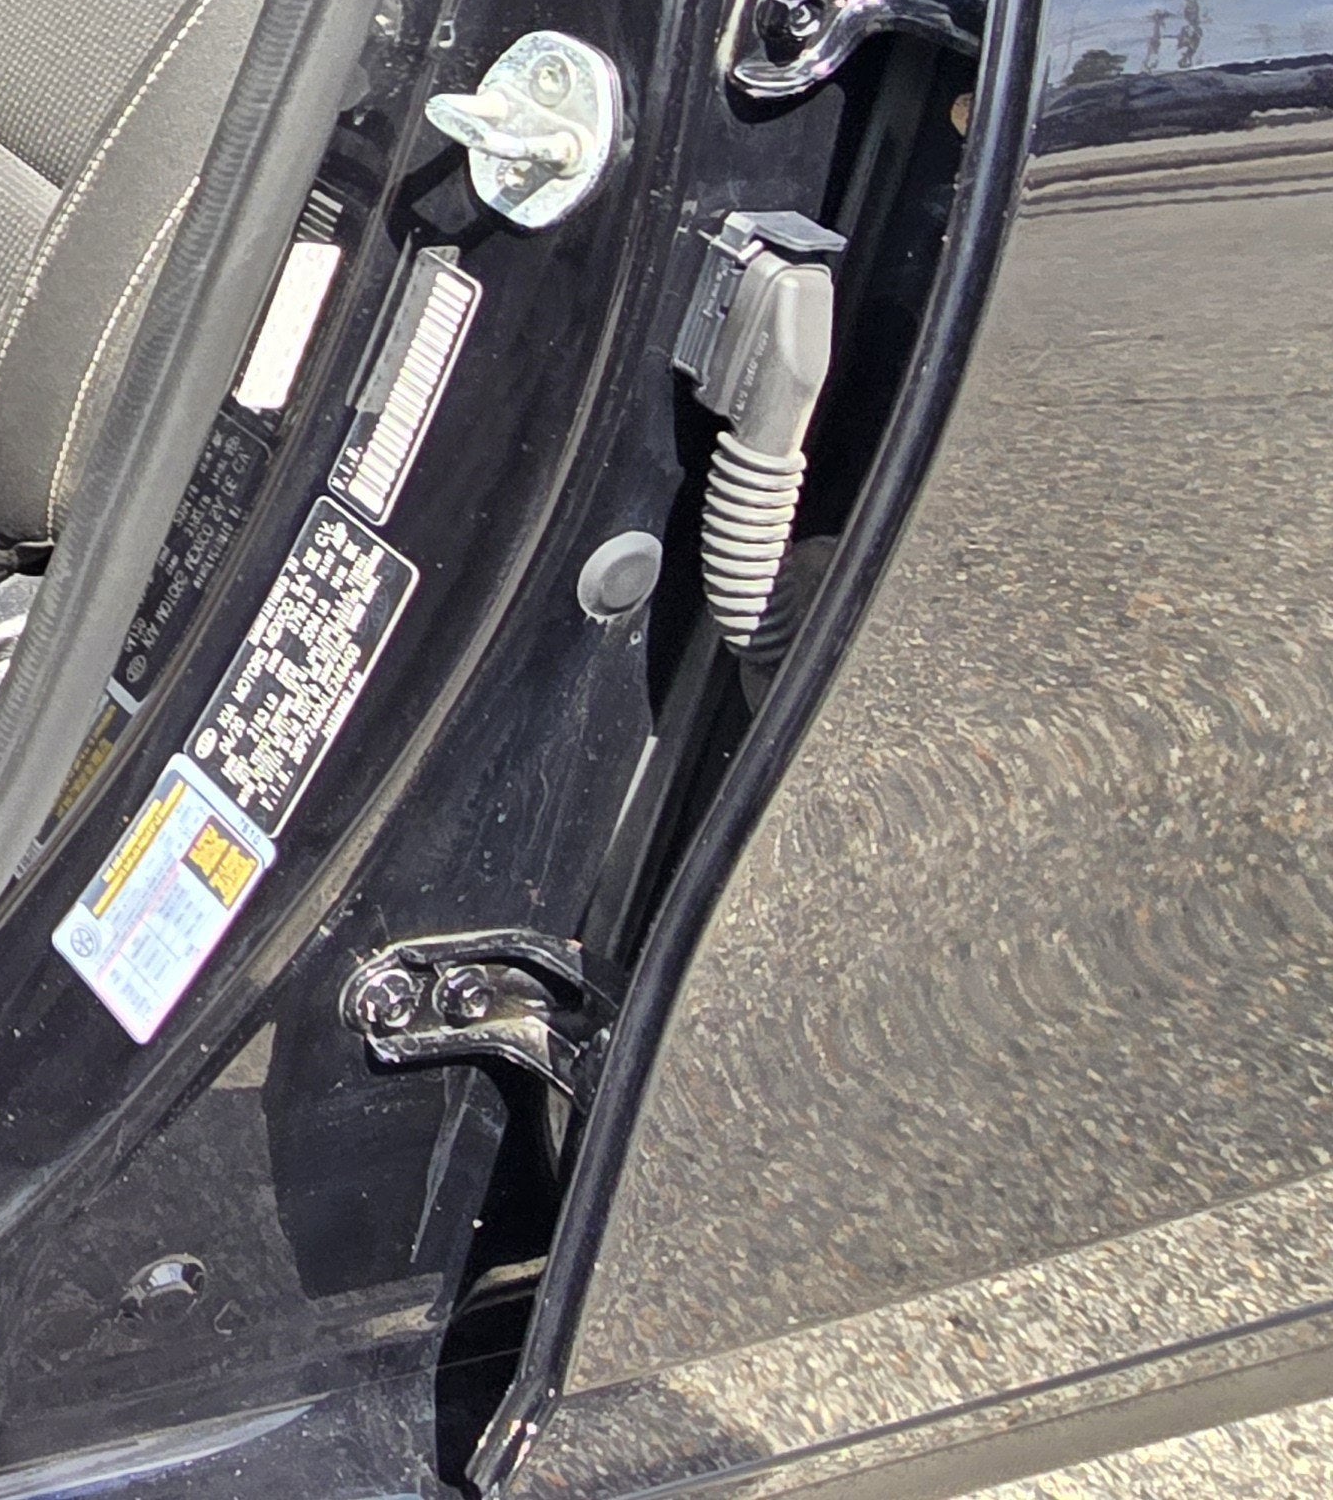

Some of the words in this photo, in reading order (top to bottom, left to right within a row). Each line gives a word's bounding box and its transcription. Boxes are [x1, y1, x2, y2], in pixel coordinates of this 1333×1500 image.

[216, 703, 239, 729] KIA
[230, 645, 270, 703] MOTORS
[261, 595, 296, 648] MEXICO
